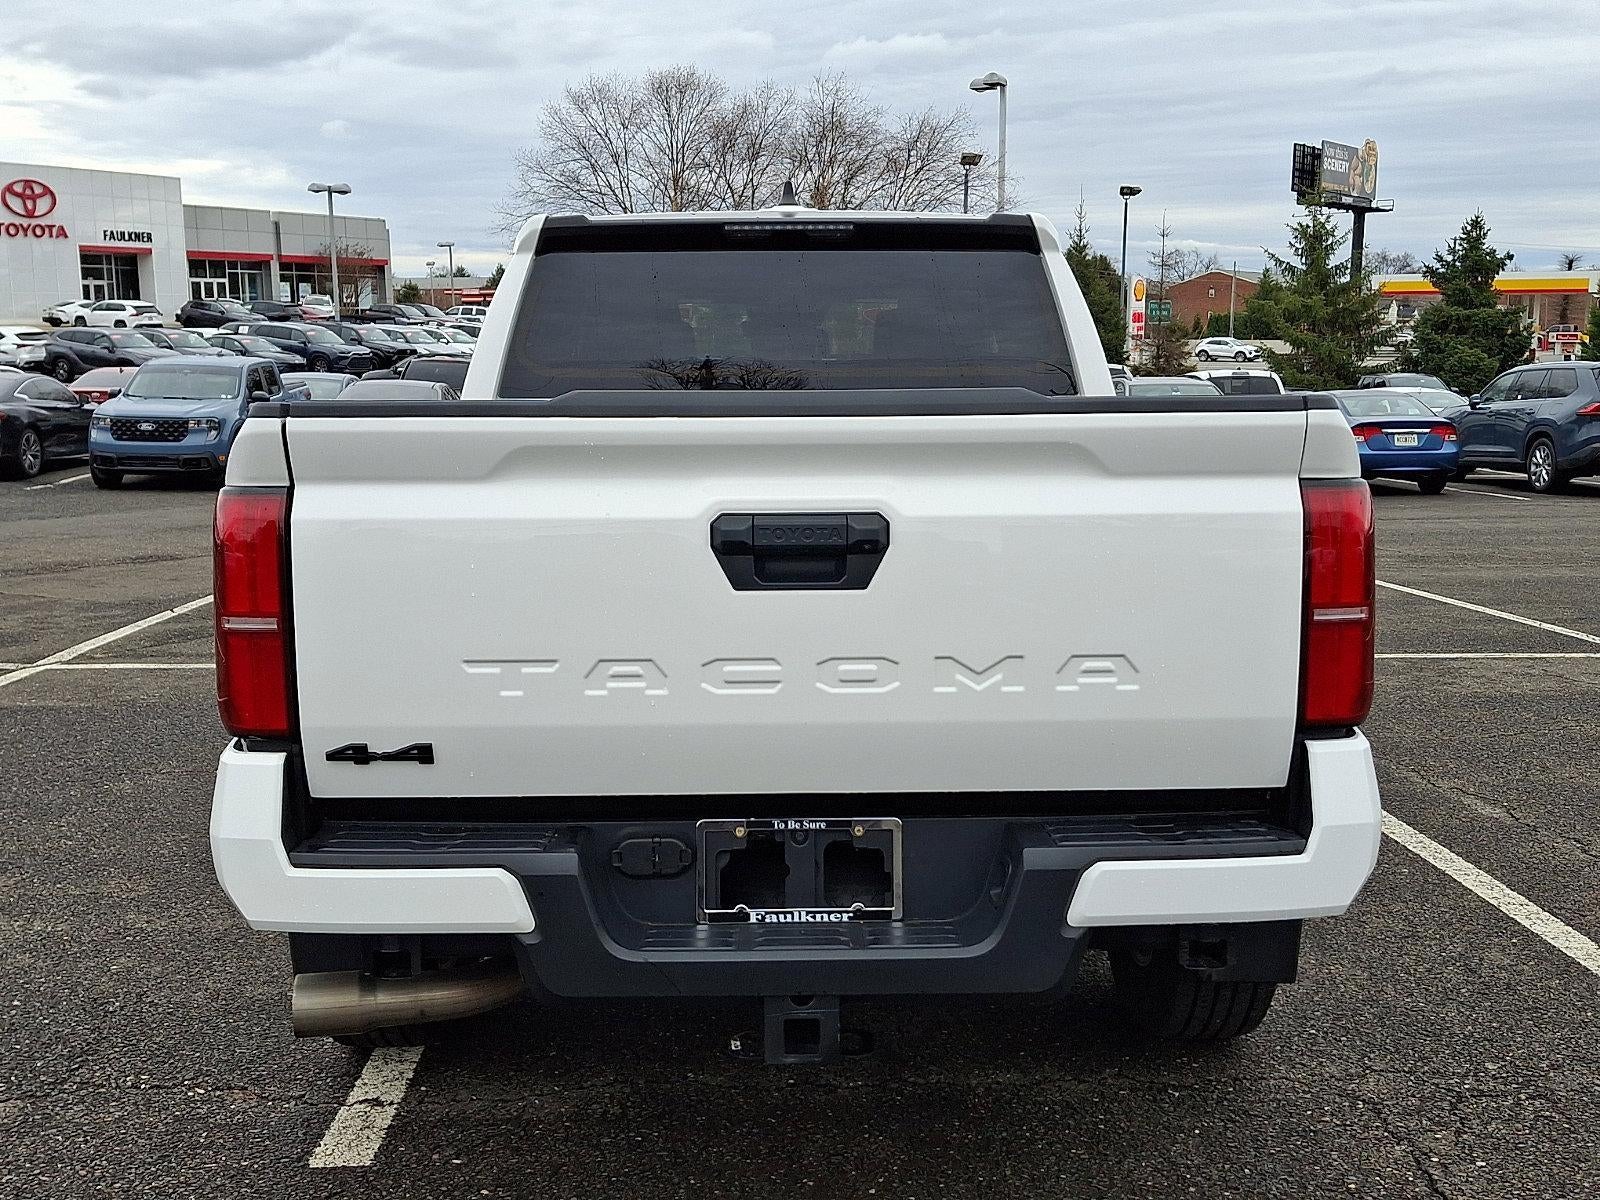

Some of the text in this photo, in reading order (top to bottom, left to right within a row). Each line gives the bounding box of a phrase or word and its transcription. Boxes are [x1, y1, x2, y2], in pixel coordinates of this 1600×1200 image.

[1323, 157, 1350, 173] SCENERY
[103, 229, 153, 243] FAULKNER
[759, 527, 843, 543] TOYOTA
[462, 653, 1140, 697] TACOMA
[772, 820, 827, 830] To Be Sure
[750, 911, 854, 923] Faulkner
